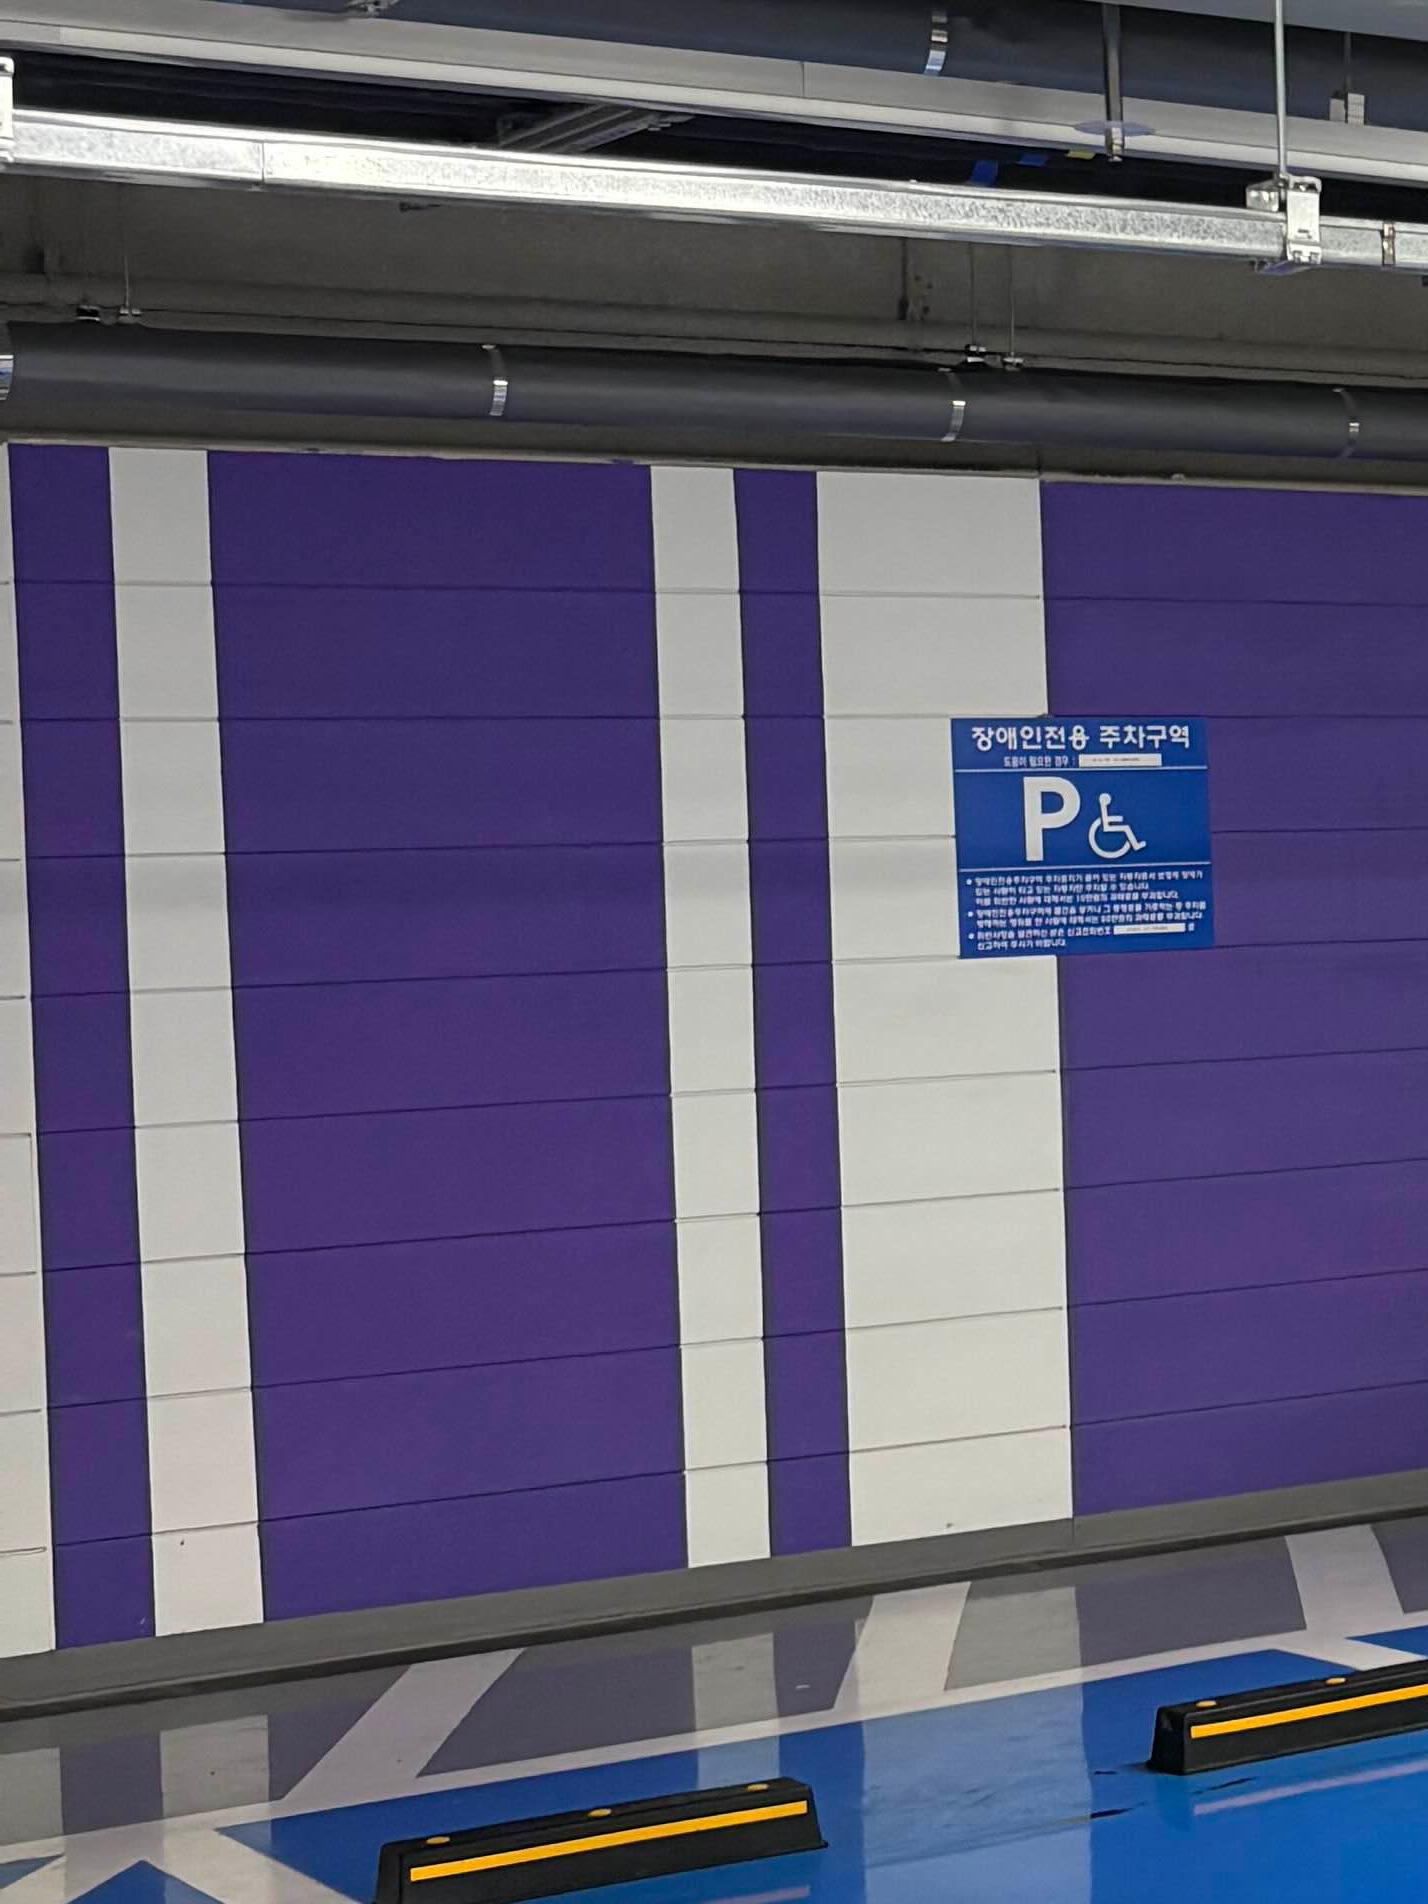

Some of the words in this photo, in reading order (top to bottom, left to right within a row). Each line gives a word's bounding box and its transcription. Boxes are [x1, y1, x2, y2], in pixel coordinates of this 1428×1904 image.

[971, 724, 1090, 751] 장애인전용
[1099, 724, 1190, 749] 주차구역
[1022, 776, 1081, 862] P
